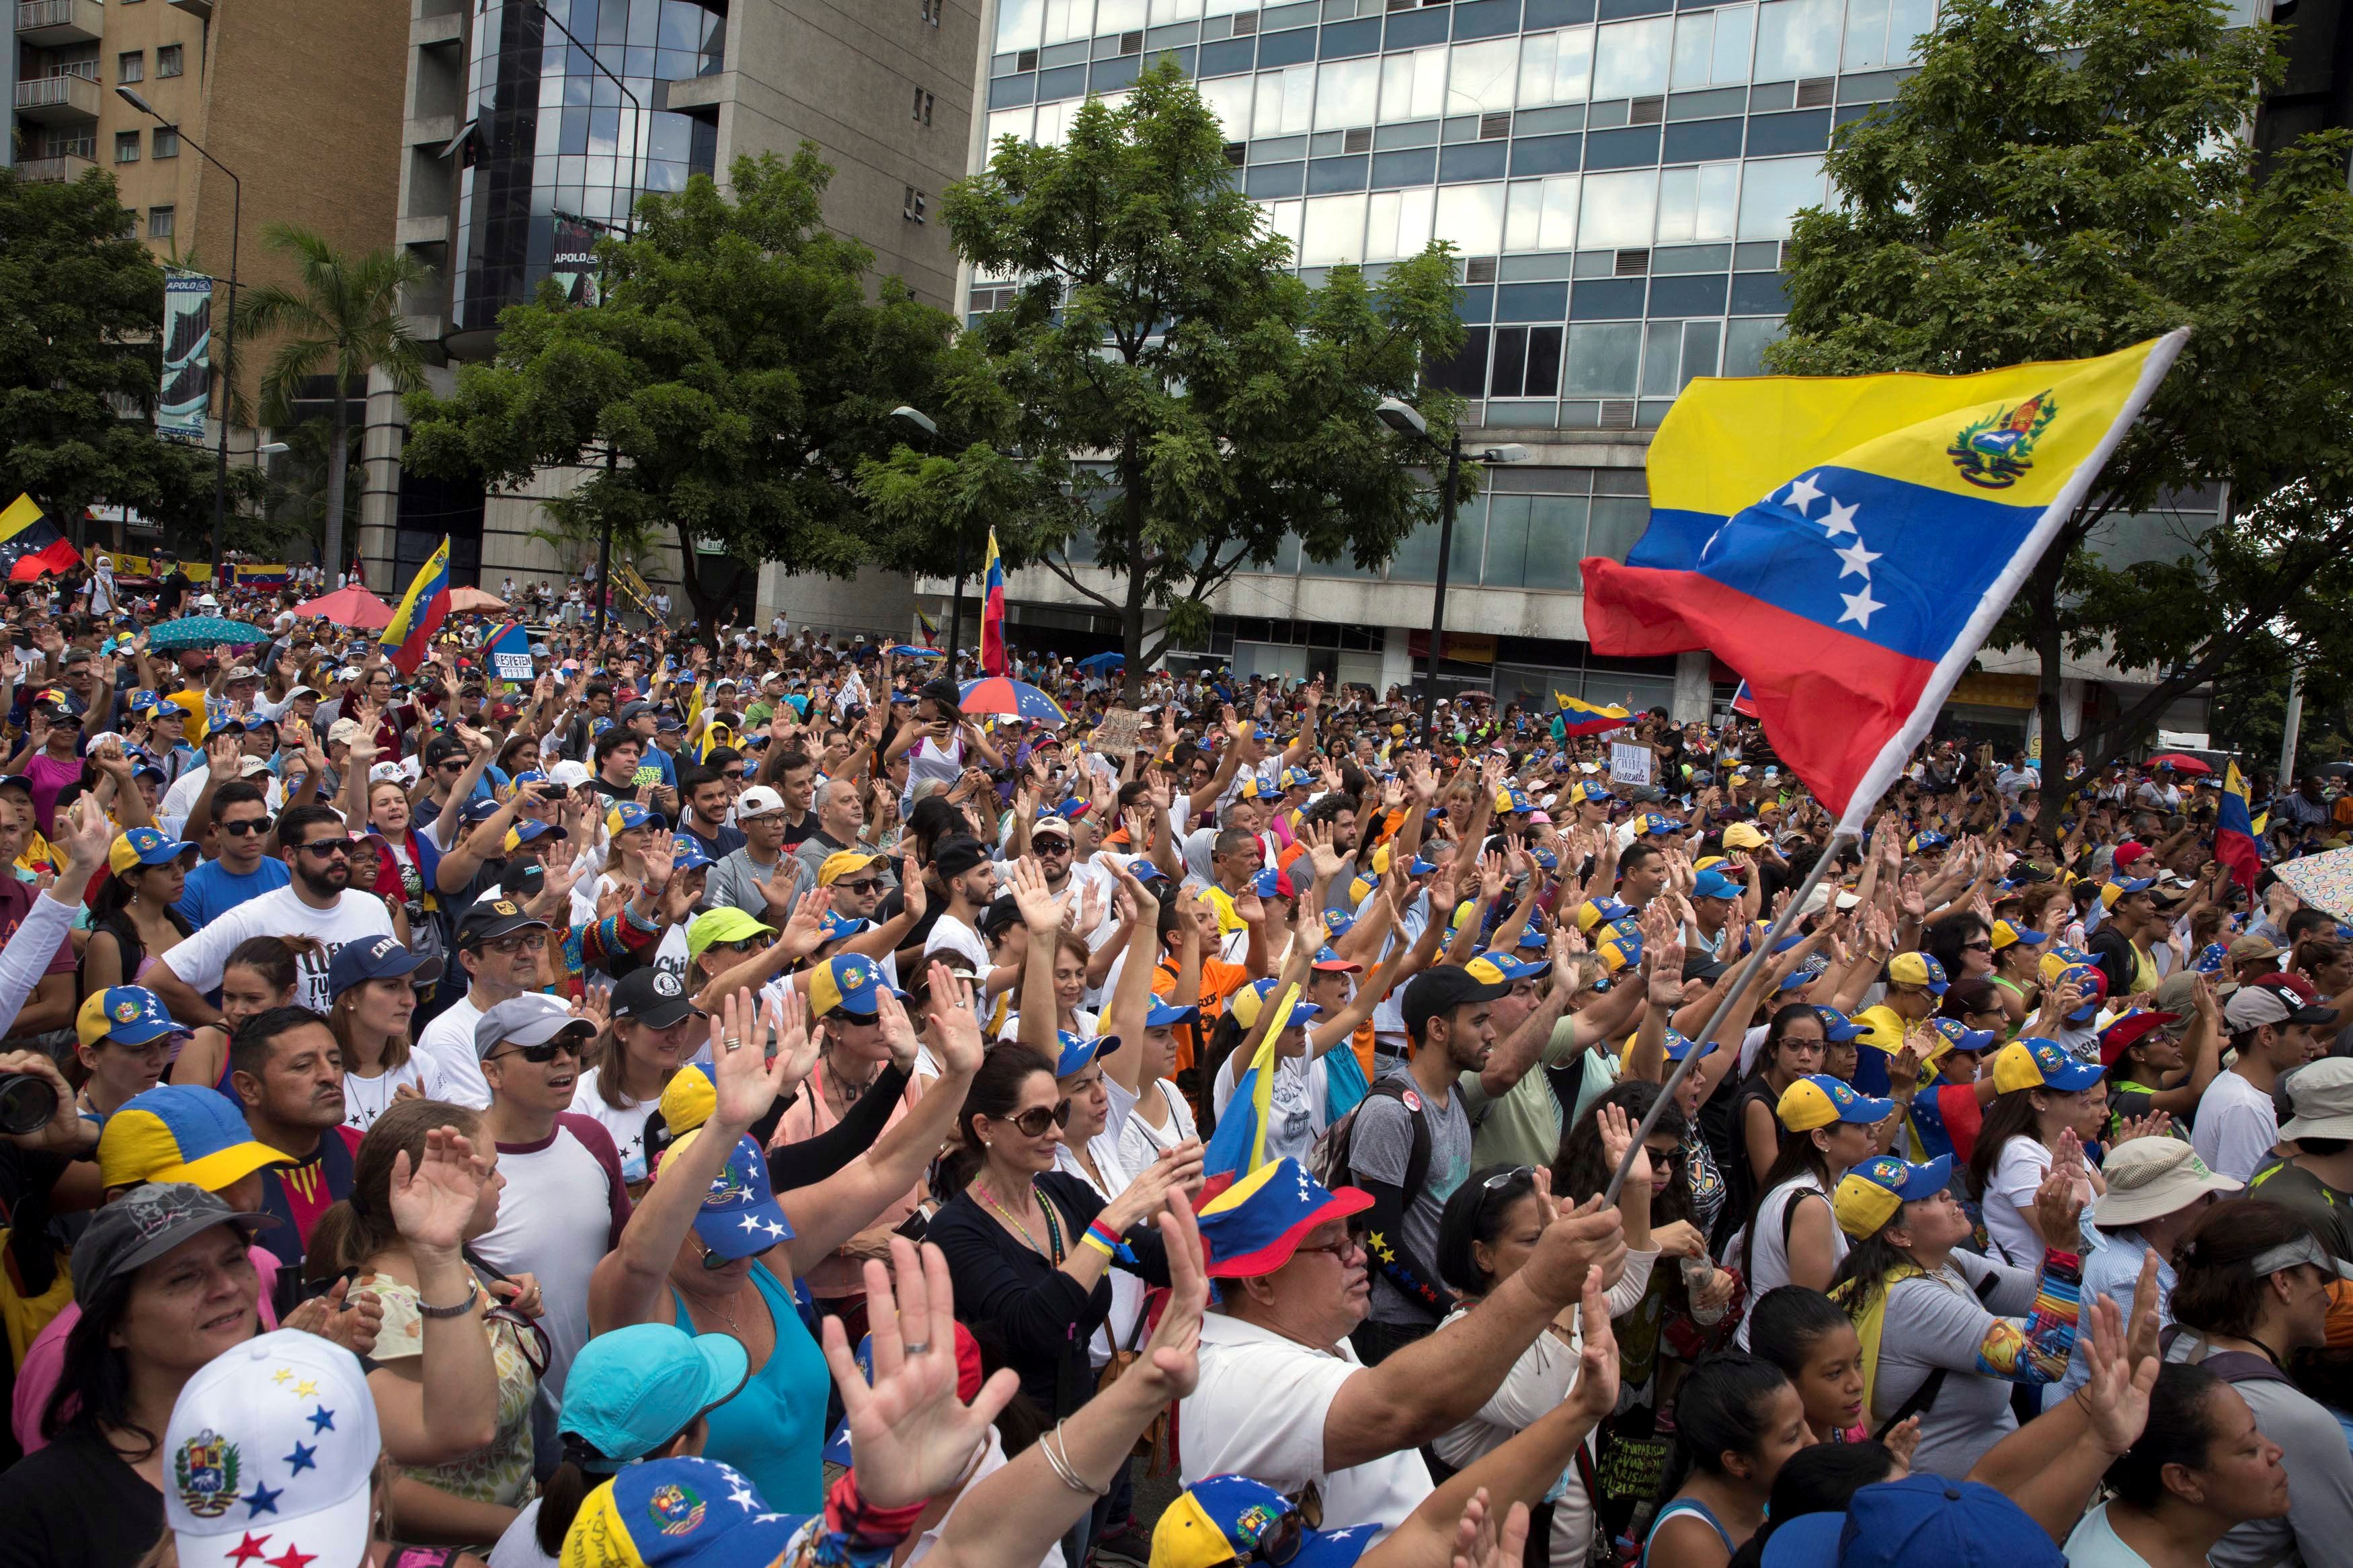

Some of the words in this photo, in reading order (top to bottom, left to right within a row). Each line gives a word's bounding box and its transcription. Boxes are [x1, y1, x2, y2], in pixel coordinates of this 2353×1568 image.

[554, 253, 587, 263] APOLO
[495, 654, 530, 666] RESPETEN
[836, 675, 857, 707] DILE
[1611, 758, 1647, 782] Venezuela
[309, 997, 317, 1007] Y
